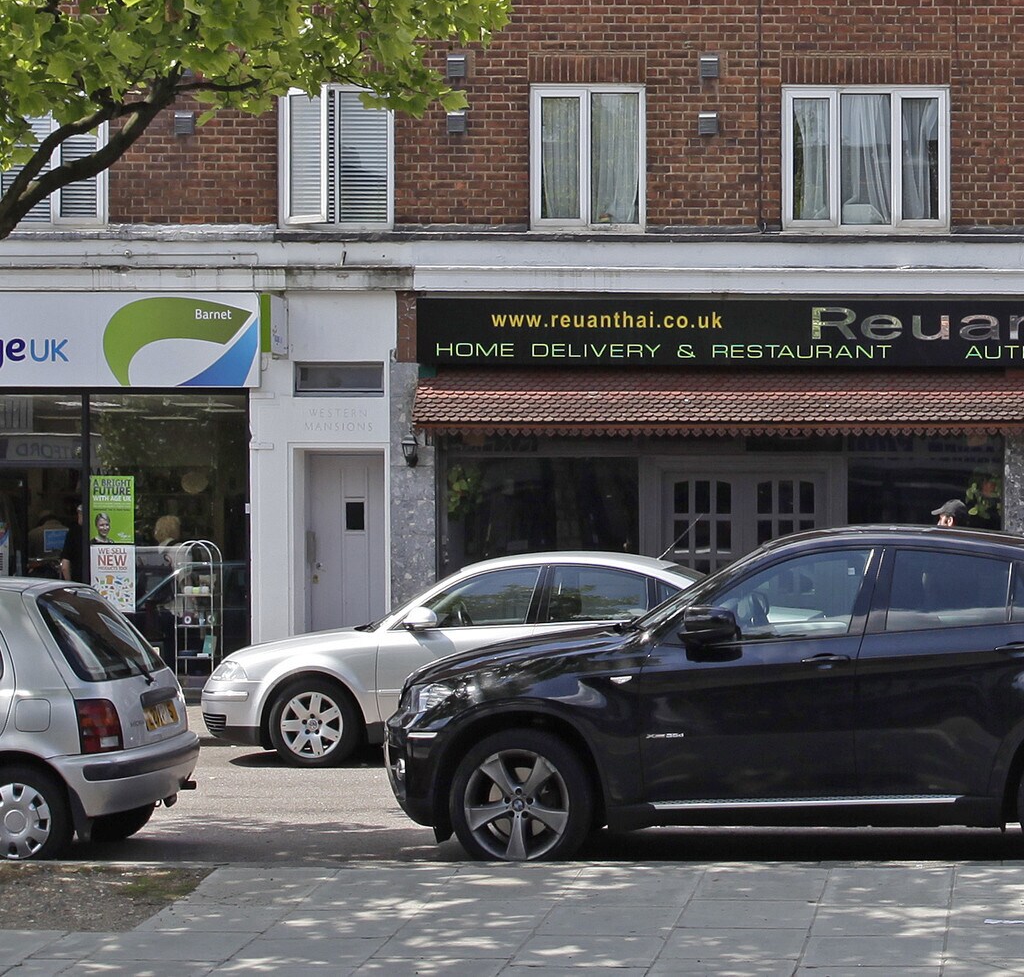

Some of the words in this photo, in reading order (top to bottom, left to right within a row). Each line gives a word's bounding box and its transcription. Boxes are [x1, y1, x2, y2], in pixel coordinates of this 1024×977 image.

[195, 308, 232, 320] Barnet
[491, 311, 723, 330] www.reuanthai.co.uk
[436, 342, 514, 358] HOME
[532, 343, 661, 358] DELIVERY
[677, 344, 696, 359] &
[712, 344, 893, 359] RESTAURANT
[309, 408, 368, 418] WESTERN
[304, 422, 374, 432] MANSIONS
[102, 479, 131, 487] BRIGHT
[94, 487, 131, 496] FUTURE
[97, 555, 127, 566] NEW
